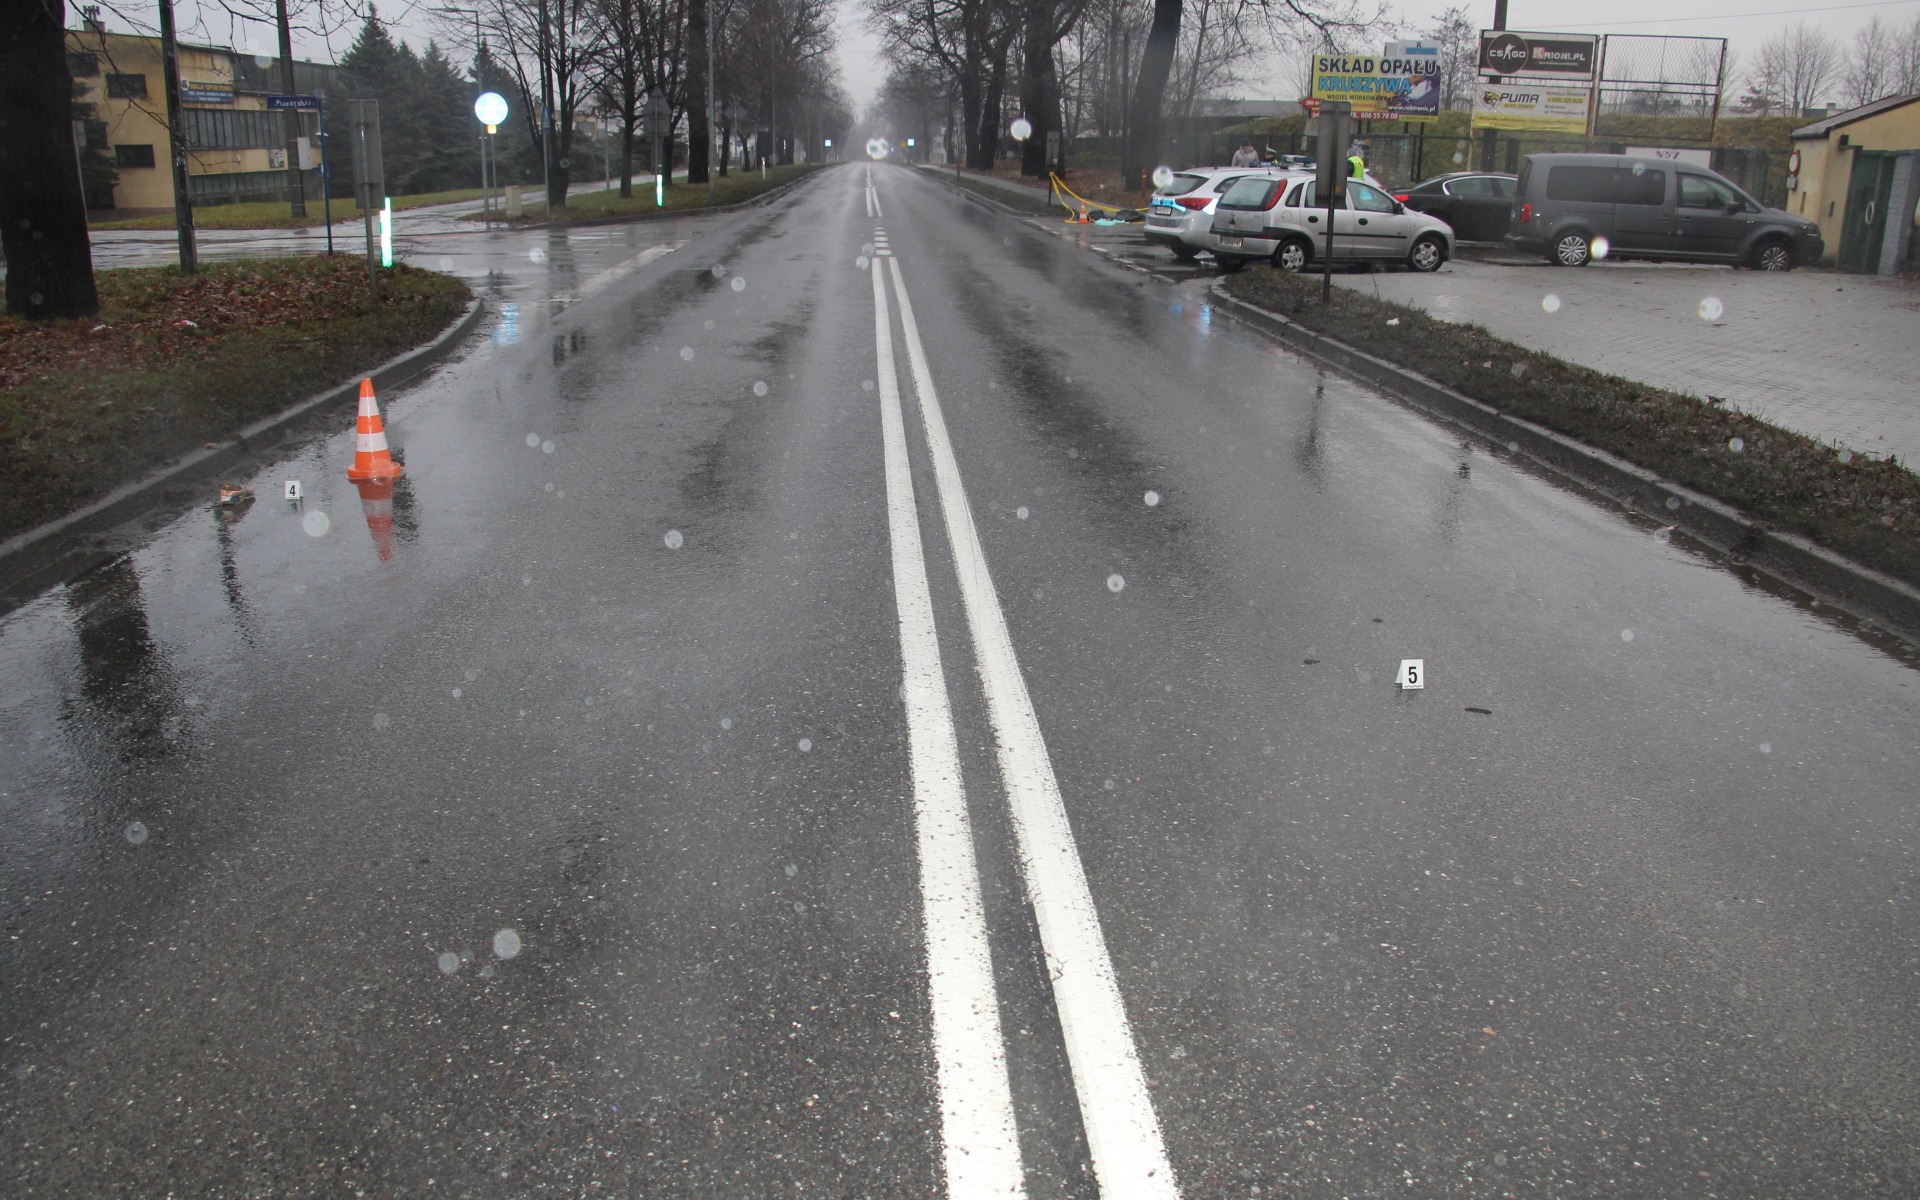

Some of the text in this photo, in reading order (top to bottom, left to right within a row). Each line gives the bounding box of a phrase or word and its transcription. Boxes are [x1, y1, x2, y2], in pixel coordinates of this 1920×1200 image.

[1319, 58, 1437, 75] SKŁAD OPAŁU
[1318, 75, 1412, 94] KRUSZYWA
[1500, 92, 1540, 104] PUMA
[1388, 104, 1436, 112] www.robtronic.pl
[289, 484, 296, 496] 4
[1408, 666, 1418, 684] 5
